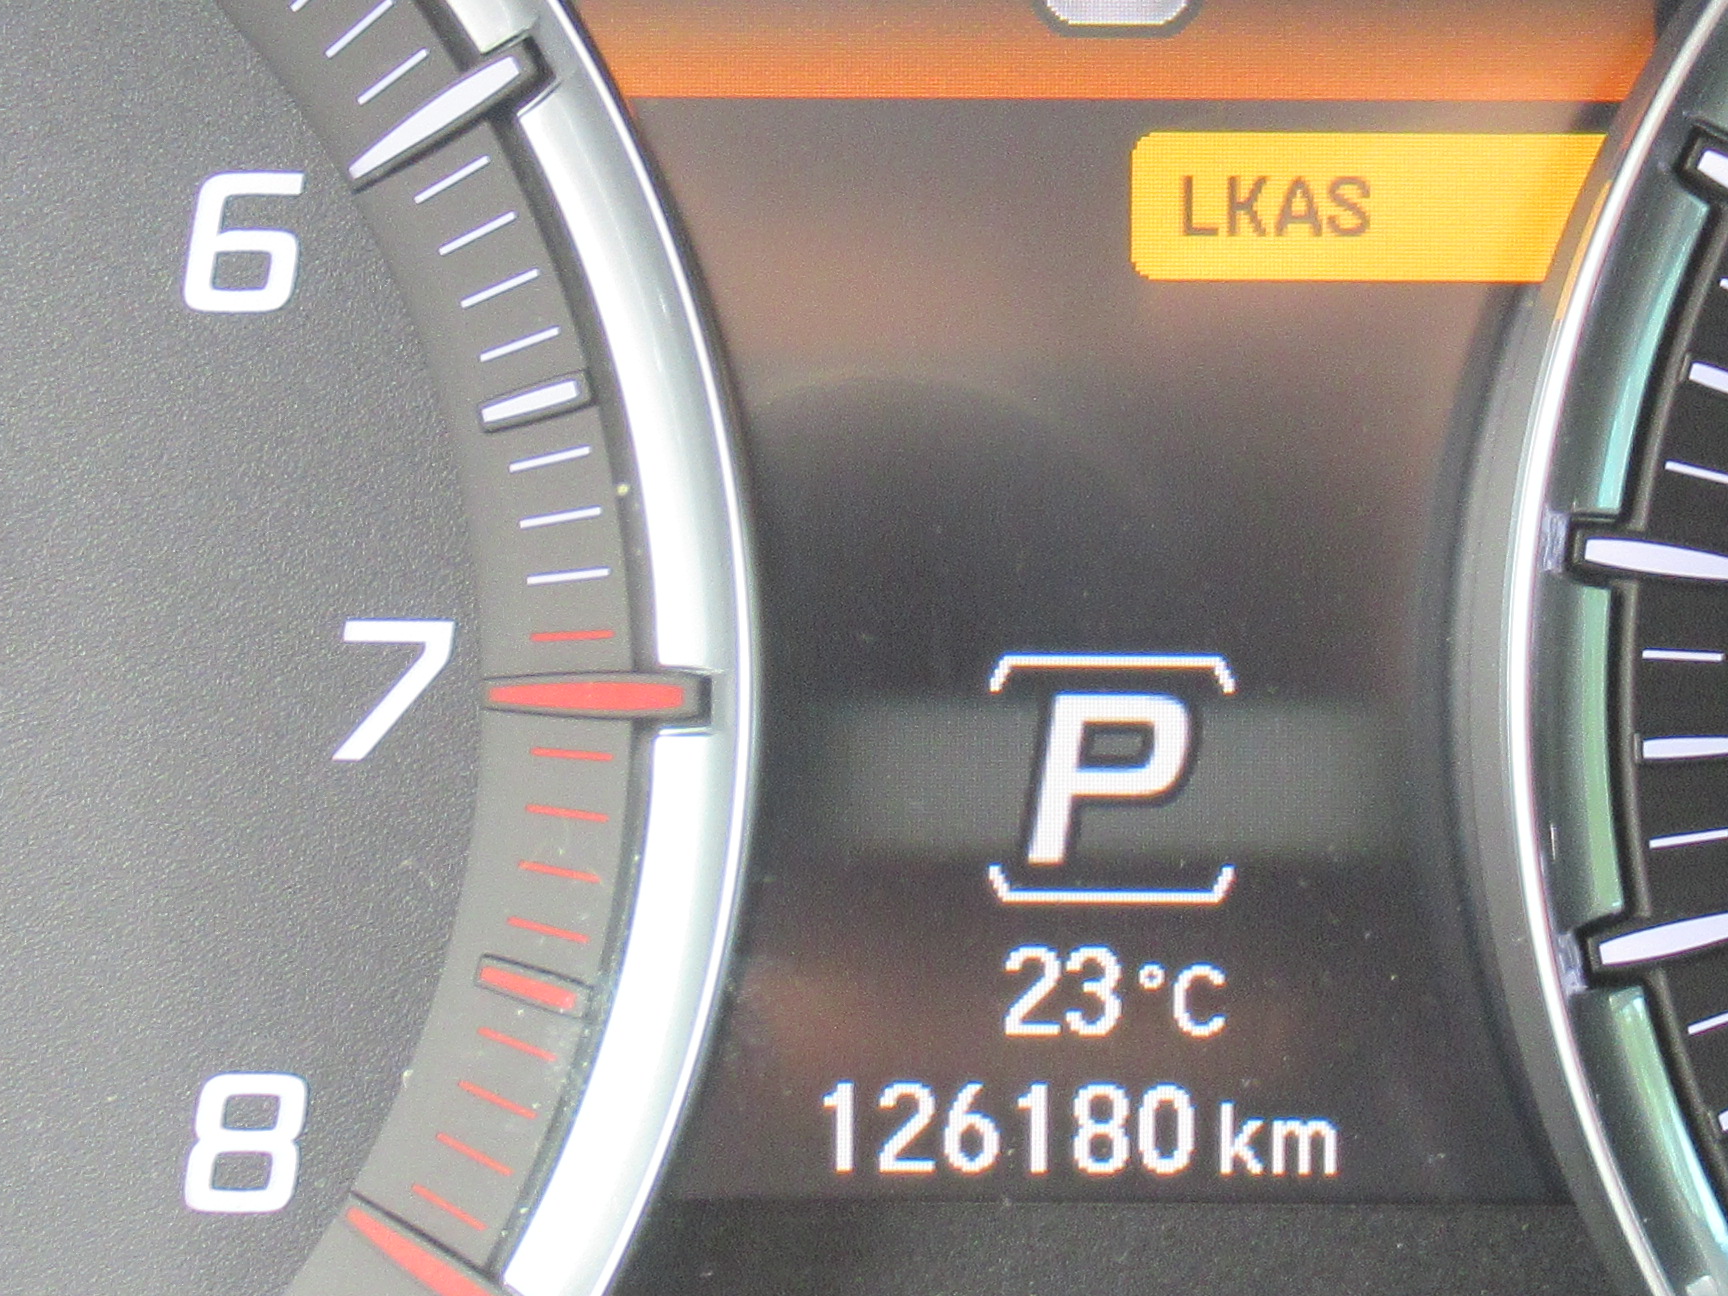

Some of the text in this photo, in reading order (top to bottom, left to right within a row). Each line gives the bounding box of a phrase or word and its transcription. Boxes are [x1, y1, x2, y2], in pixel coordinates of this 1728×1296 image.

[182, 171, 306, 314] 6
[1181, 174, 1372, 237] LKAS
[331, 619, 457, 762] 7
[1027, 693, 1189, 864] P
[183, 1072, 308, 1214] 8
[821, 1080, 1339, 1177] 126180 km
